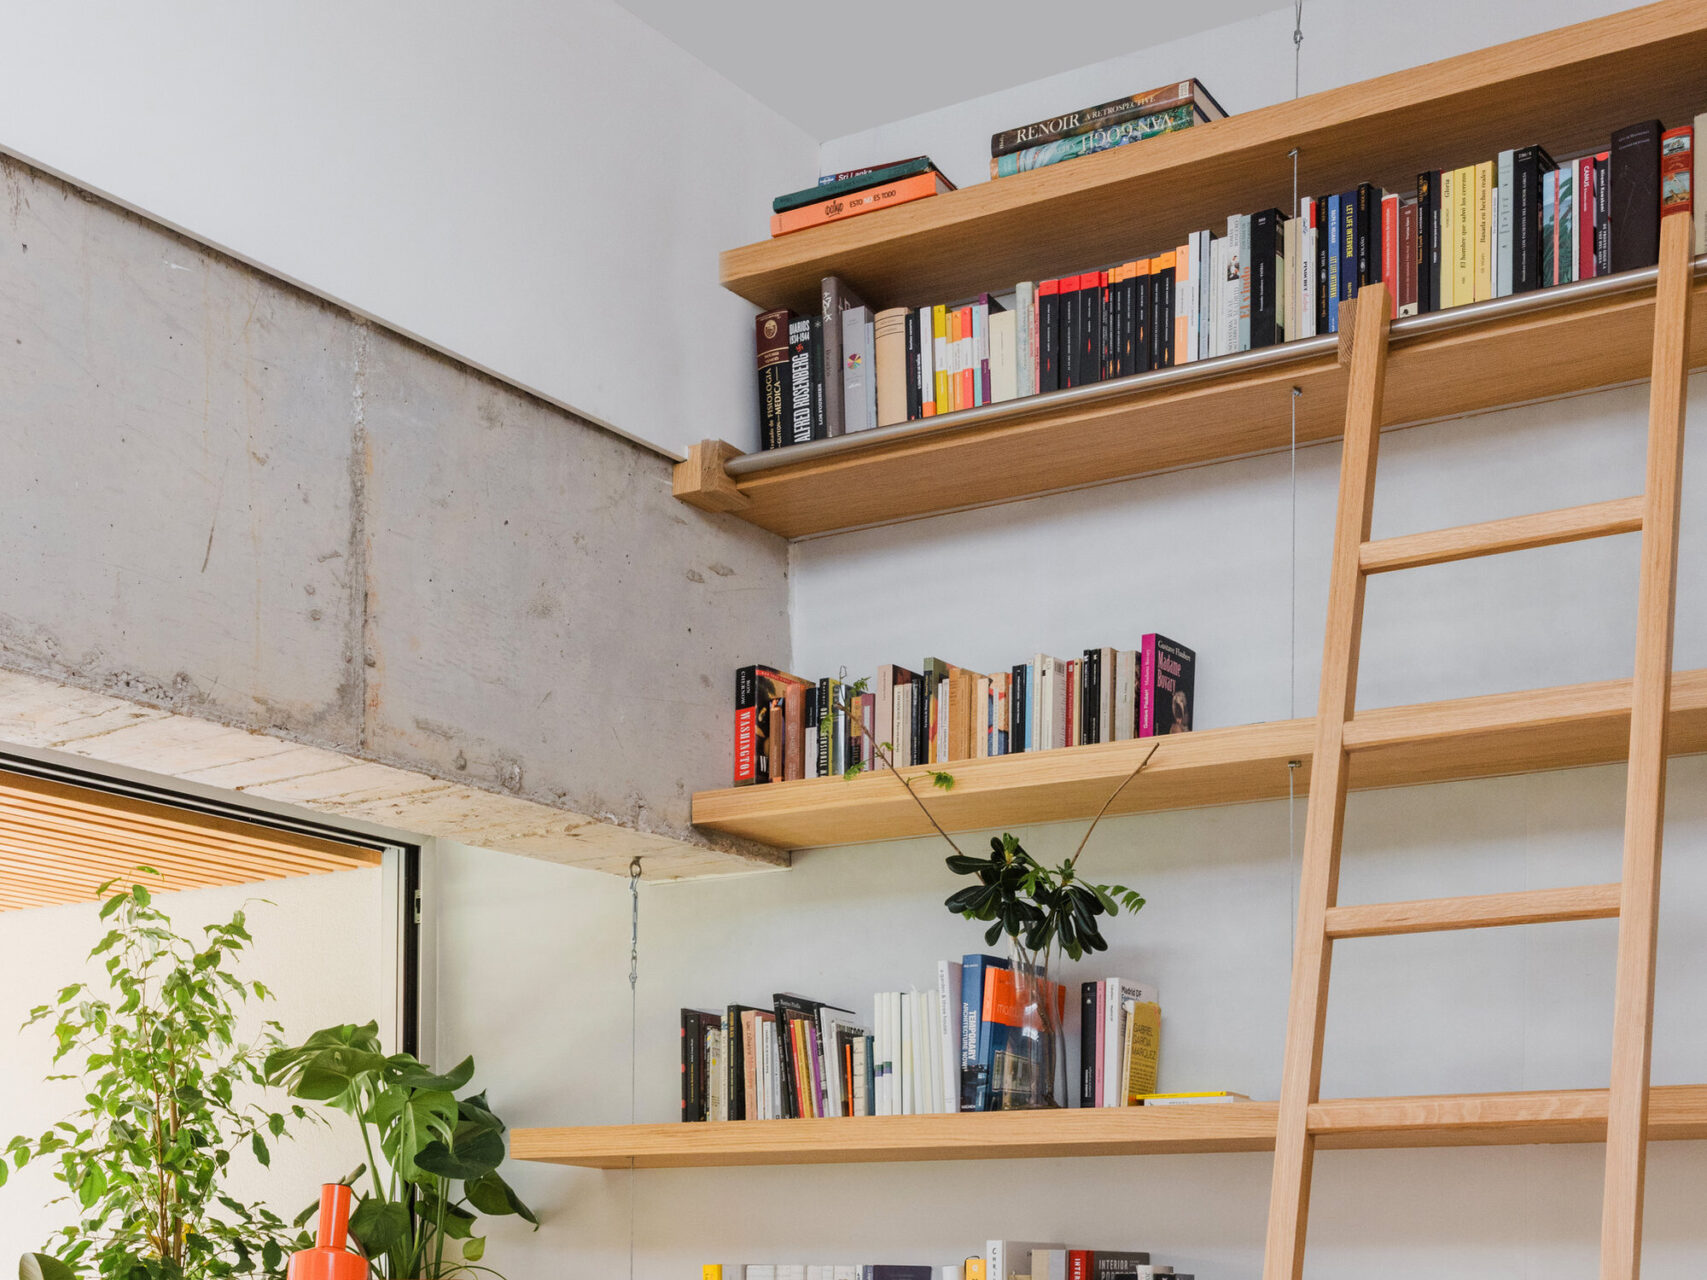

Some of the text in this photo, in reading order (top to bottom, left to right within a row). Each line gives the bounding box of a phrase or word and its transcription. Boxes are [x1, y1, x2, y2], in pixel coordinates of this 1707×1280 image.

[1092, 96, 1156, 120] RETROSPECTIVE
[1016, 113, 1080, 145] RENOIR
[1080, 113, 1172, 155] VAN GOGH
[838, 173, 850, 181] Sri
[850, 198, 863, 208] ESTO
[873, 194, 881, 202] ES
[882, 189, 896, 199] TODO
[765, 367, 774, 418] FISIOLOGIA
[774, 381, 782, 415] MEDICA
[792, 353, 812, 443] ALFRED ROSENBERG
[1157, 650, 1181, 678] Madame
[1158, 640, 1192, 662] Gustave Flaubert
[1157, 668, 1177, 696] Bovary
[739, 711, 750, 777] WASHINGTON
[1121, 985, 1136, 997] Madrid
[962, 1001, 970, 1049] ARCHITECTURE
[967, 1009, 977, 1061] TEMPORARY
[1133, 1023, 1153, 1037] GABRIEL
[1098, 1259, 1128, 1271] INTERIOR
